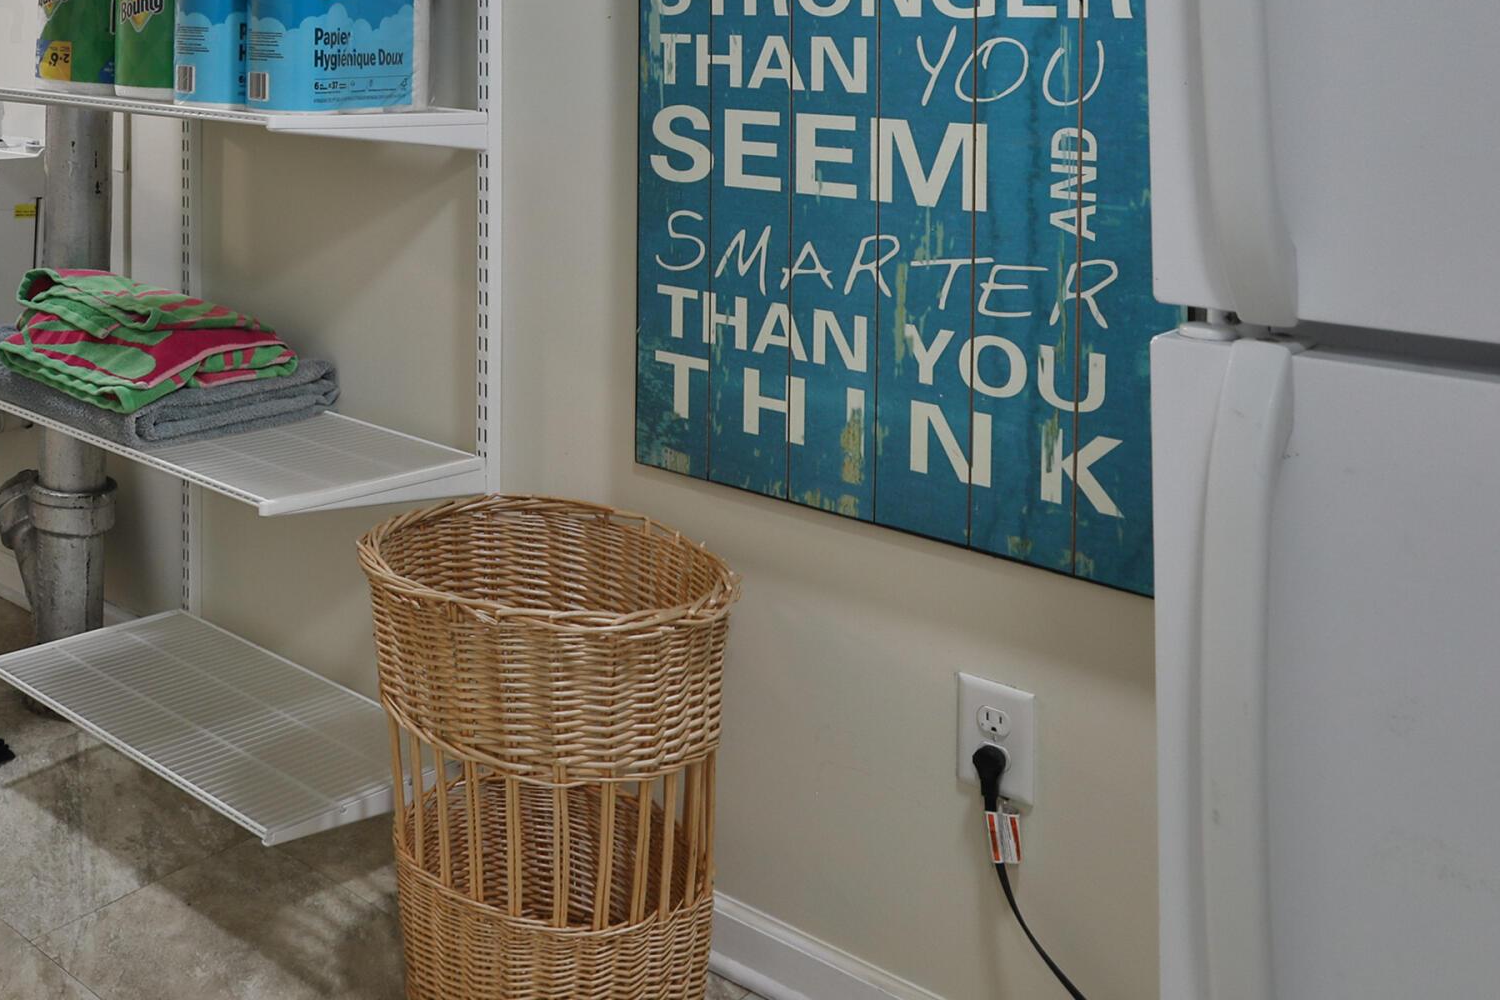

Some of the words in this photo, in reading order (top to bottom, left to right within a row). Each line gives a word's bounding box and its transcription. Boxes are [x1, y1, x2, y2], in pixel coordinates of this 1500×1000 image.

[314, 27, 351, 49] Papier
[314, 49, 376, 71] Hygiénique
[378, 49, 404, 66] Doux
[658, 33, 869, 94] THAN
[916, 26, 1106, 107] YOU
[649, 104, 988, 212] SEEM
[1050, 127, 1097, 242] AND
[654, 210, 1119, 329] SMARTER
[656, 284, 868, 373] THAN
[905, 323, 1106, 413] YOU
[654, 349, 1126, 519] THINK
